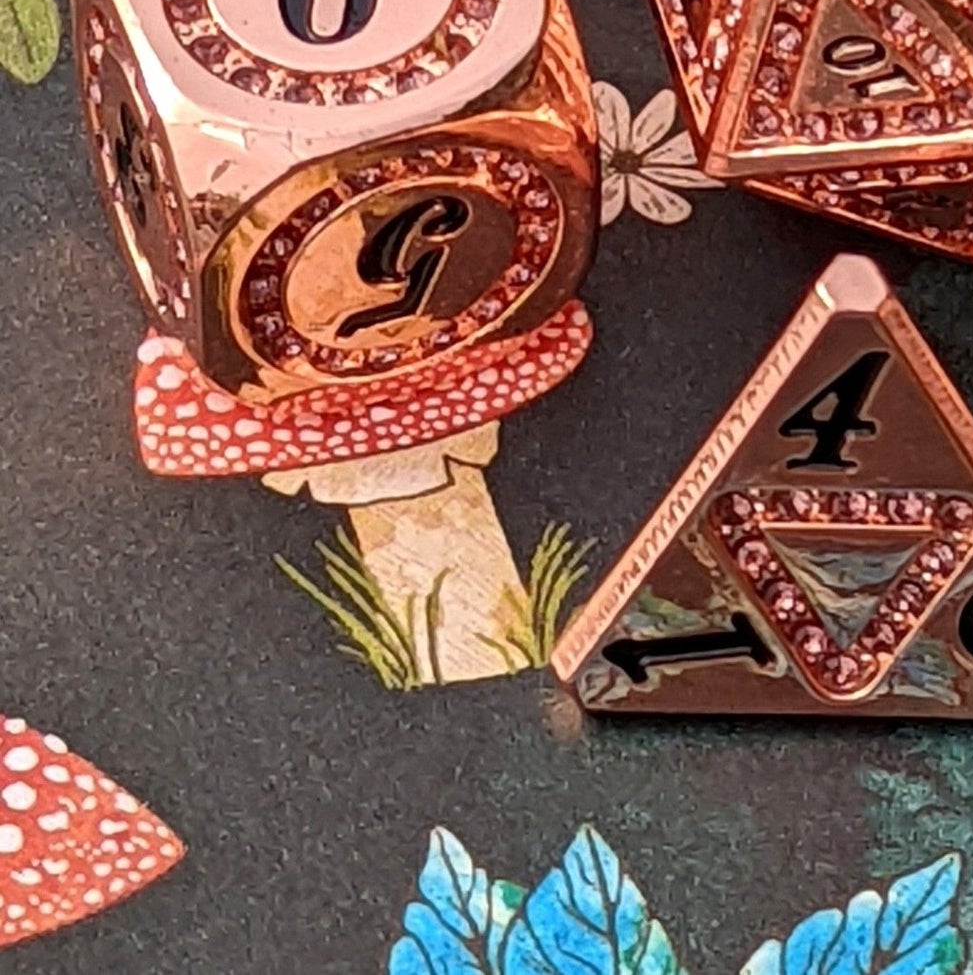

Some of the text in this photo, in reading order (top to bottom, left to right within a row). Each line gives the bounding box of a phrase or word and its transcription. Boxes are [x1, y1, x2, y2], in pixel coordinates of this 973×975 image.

[822, 34, 923, 104] 10
[334, 195, 473, 340] 5
[778, 350, 891, 470] 4
[601, 612, 777, 684] 1
